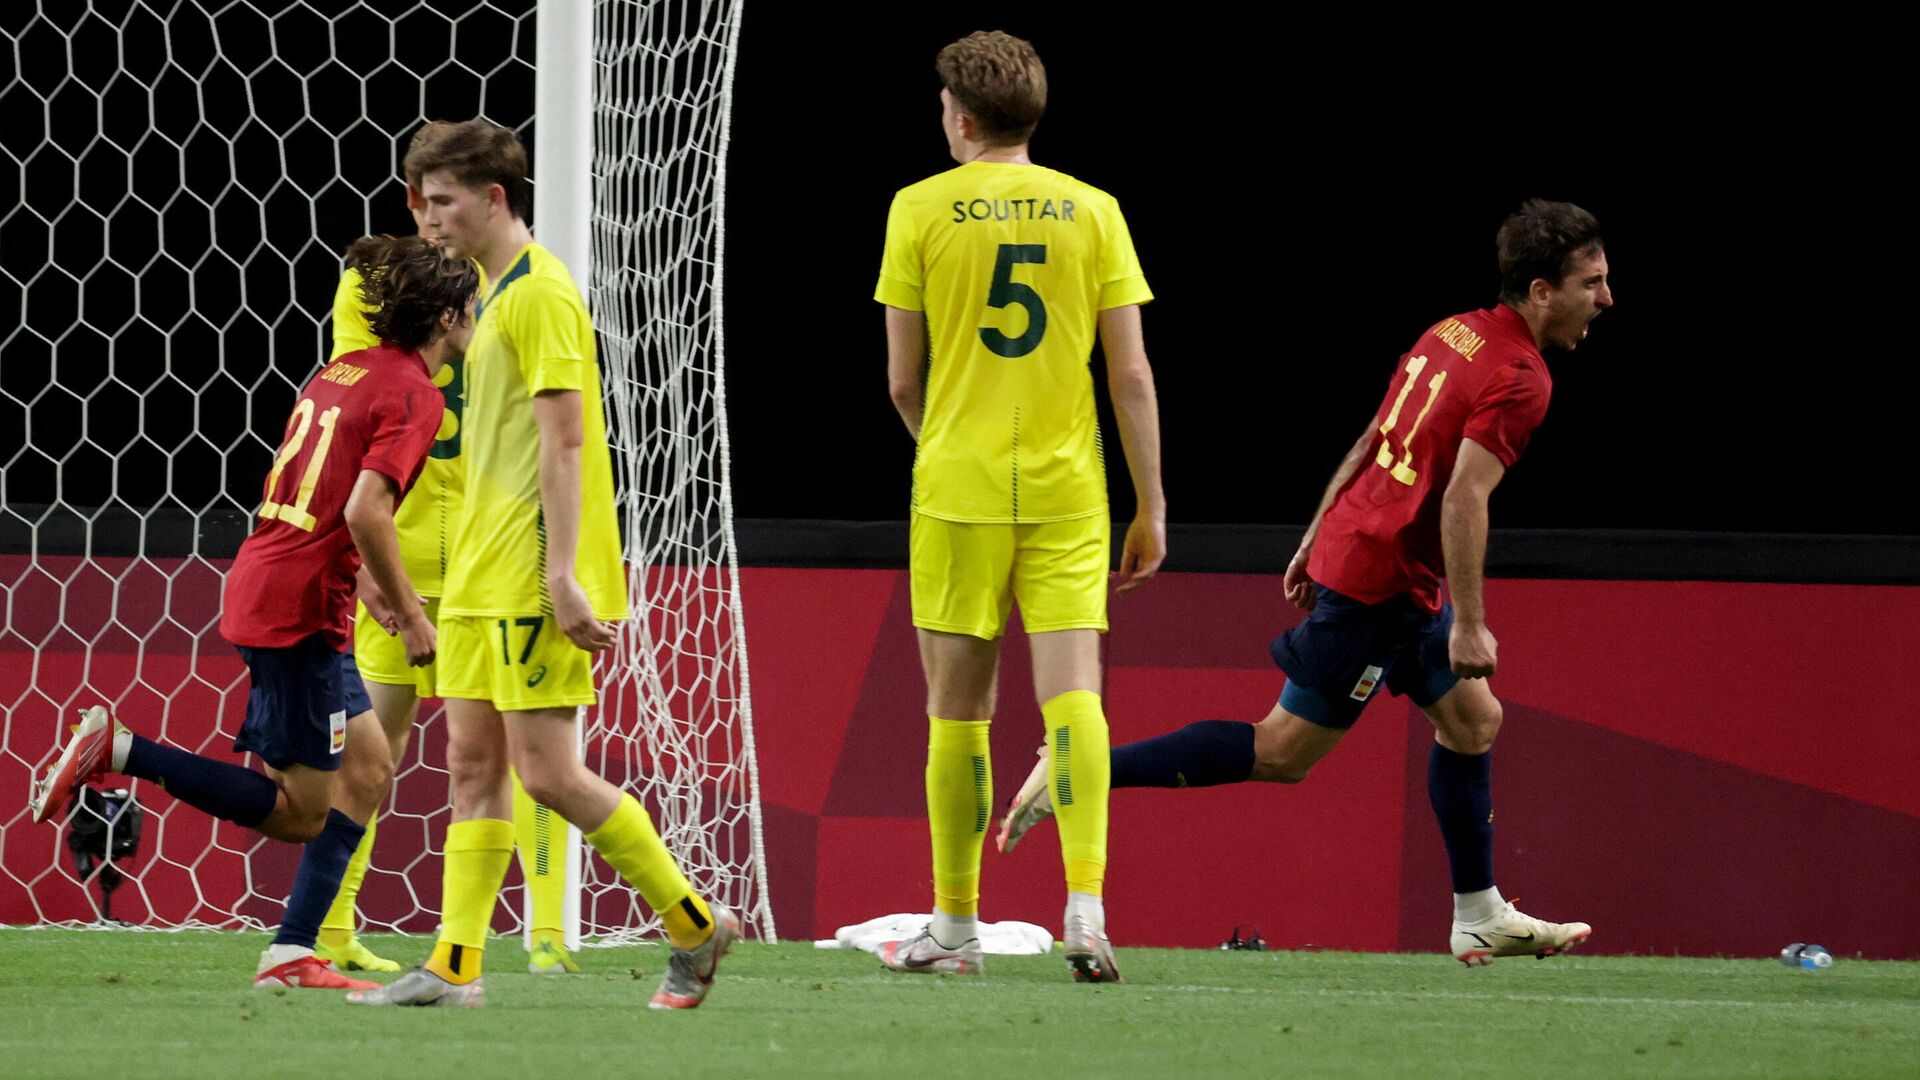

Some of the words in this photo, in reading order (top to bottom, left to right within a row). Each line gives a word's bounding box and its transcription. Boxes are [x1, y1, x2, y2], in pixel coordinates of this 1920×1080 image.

[952, 198, 1075, 223] SOUTTAR
[979, 244, 1047, 358] 5
[321, 362, 369, 387] BRYAN
[1376, 355, 1447, 486] 11
[259, 398, 341, 532] 21
[498, 616, 544, 666] 17
